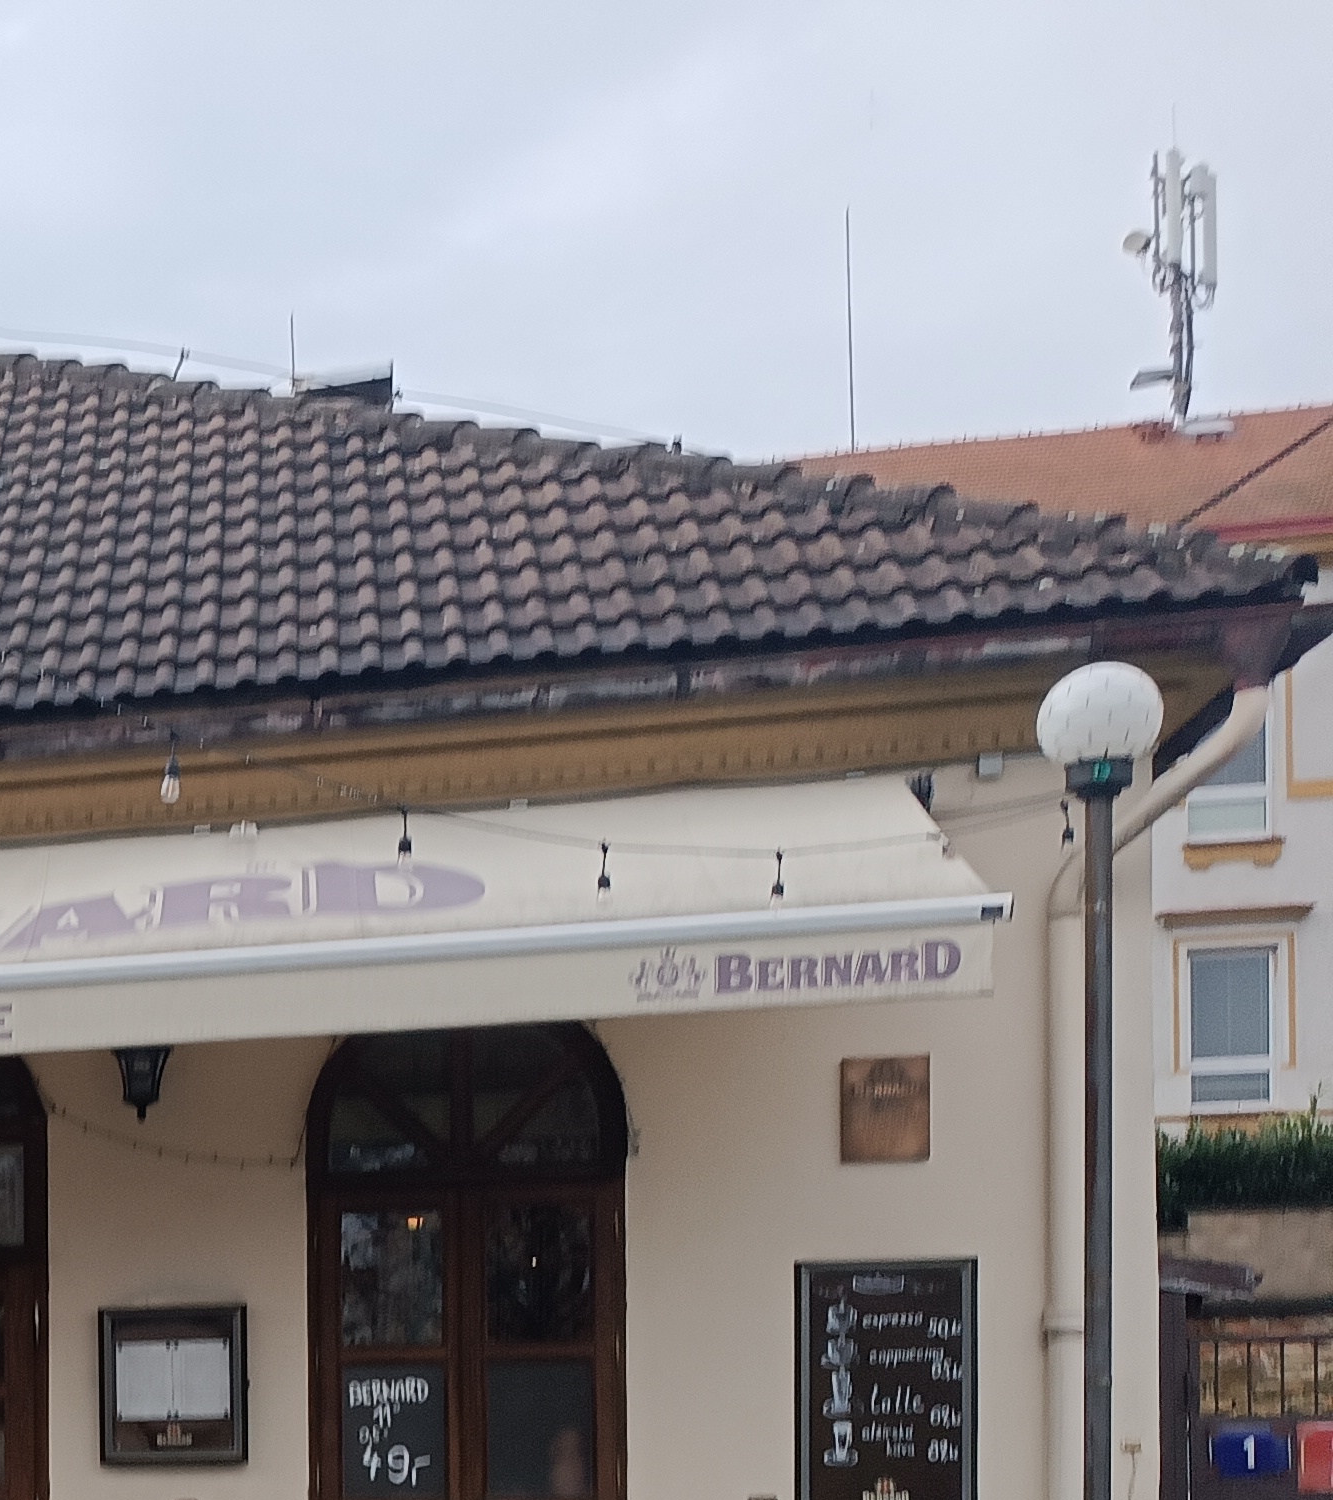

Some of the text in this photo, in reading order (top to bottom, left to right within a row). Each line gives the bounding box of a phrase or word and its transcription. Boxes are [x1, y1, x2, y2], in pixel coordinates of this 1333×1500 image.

[714, 938, 963, 995] BERNARD
[349, 1376, 429, 1408] BERNARD
[1241, 1432, 1257, 1471] 1
